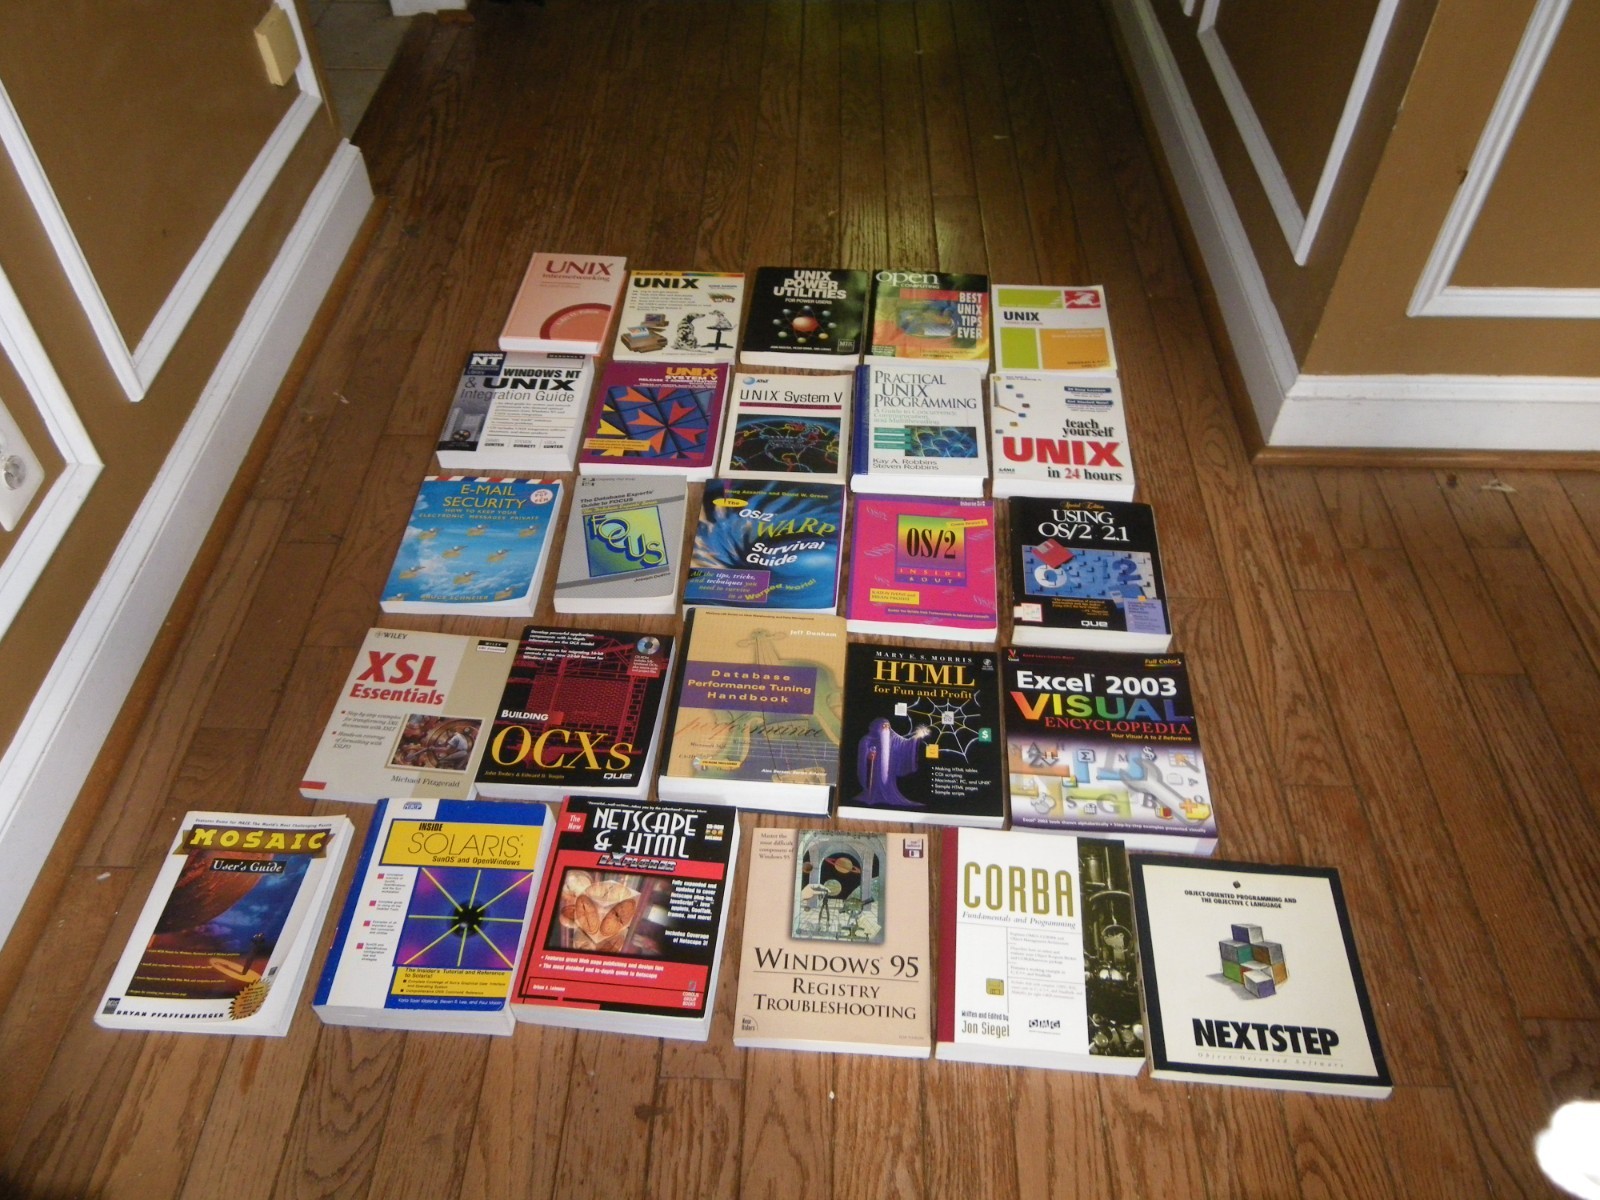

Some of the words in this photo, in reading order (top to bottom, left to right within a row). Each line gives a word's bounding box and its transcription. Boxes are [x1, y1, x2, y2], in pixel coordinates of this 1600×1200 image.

[546, 260, 614, 276] UNIX
[793, 270, 832, 281] UNIX
[875, 271, 939, 287] open
[633, 277, 699, 289] UNIX
[783, 278, 839, 290] POWER
[773, 286, 847, 299] UTILITIES
[959, 292, 983, 304] BEST
[957, 303, 983, 315] UNIX
[1003, 311, 1040, 321] UNIX
[961, 315, 983, 327] TIPS
[957, 327, 983, 339] EVER
[470, 357, 503, 367] NT
[504, 368, 563, 378] WINDOWS
[565, 370, 582, 379] NT
[666, 367, 718, 376] UNIX
[465, 377, 477, 388] &
[483, 377, 576, 391] UNIX
[882, 383, 928, 397] UNIX
[460, 389, 531, 402] Integration
[535, 390, 576, 403] Guide
[740, 389, 780, 402] UNIX
[784, 390, 830, 405] System
[834, 392, 843, 403] V
[1064, 418, 1099, 429] teach
[1062, 426, 1114, 438] yourself
[1002, 436, 1124, 467] UNIX
[1047, 467, 1061, 478] in
[1064, 467, 1080, 479] 24
[1084, 468, 1122, 481] hours
[460, 484, 516, 496] E-MAIL
[442, 496, 527, 509] SECURITY
[738, 508, 774, 522] OS/2
[1051, 508, 1115, 524] USING
[757, 517, 836, 538] WARP
[1038, 522, 1092, 540] OS/2
[1101, 525, 1130, 542] 2.1
[751, 540, 825, 555] Survival
[906, 527, 956, 559] OS/2
[745, 553, 798, 567] Guide
[383, 632, 408, 640] WILEY
[806, 630, 837, 638] Dunham
[875, 650, 904, 659] MARY
[931, 655, 973, 663] MORRIS
[356, 650, 438, 687] XSL
[711, 669, 791, 681] Database
[873, 659, 975, 687] HTML
[688, 679, 766, 691] Performance
[769, 683, 812, 695] Tuning
[1016, 670, 1093, 693] Excel
[1105, 675, 1177, 697] 2003
[349, 682, 445, 706] Essentials
[707, 691, 789, 703] Handbook
[873, 685, 890, 694] for
[893, 686, 914, 696] Fun
[917, 688, 937, 697] and
[940, 690, 972, 700] Profit
[1010, 691, 1191, 724] VISUAL
[501, 709, 549, 721] BUILDING
[1044, 716, 1192, 735] ENCYCLOPEDIA
[491, 725, 633, 771] OCXs
[391, 774, 421, 786] Michael
[421, 777, 460, 788] Fitzgerald
[569, 814, 581, 822] The
[593, 807, 698, 836] NETSCAPE
[418, 822, 444, 832] INSIDE
[568, 822, 582, 830] New
[189, 828, 326, 850] MOSAIC
[594, 829, 613, 851] &
[622, 832, 690, 858] HTML
[213, 858, 247, 872] User's
[249, 861, 283, 873] Guide
[432, 855, 456, 863] SunOS
[472, 857, 520, 866] OpenWindows
[963, 861, 1074, 918] CORBA
[1183, 889, 1235, 899] OBJECT-ORIENTED
[1236, 893, 1283, 902] PROGRAMMING
[1213, 898, 1244, 906] OBJECTIVE
[1250, 901, 1282, 909] LANGUAGE
[962, 911, 1011, 923] Fundamentals
[1030, 917, 1076, 930] Programming
[686, 931, 710, 939] Coverage
[754, 947, 881, 976] WINDOWS
[890, 954, 920, 979] 95
[594, 967, 615, 975] in-depth
[635, 971, 658, 979] Netscape
[792, 977, 881, 999] REGISTRY
[753, 993, 917, 1020] TROUBLESHOOTING
[961, 1010, 978, 1018] Written
[987, 1012, 1002, 1020] Edited
[1003, 1013, 1009, 1022] by
[961, 1020, 978, 1034] Jon
[981, 1021, 1010, 1039] Siegel
[1192, 1018, 1339, 1056] NEXTSTEP
